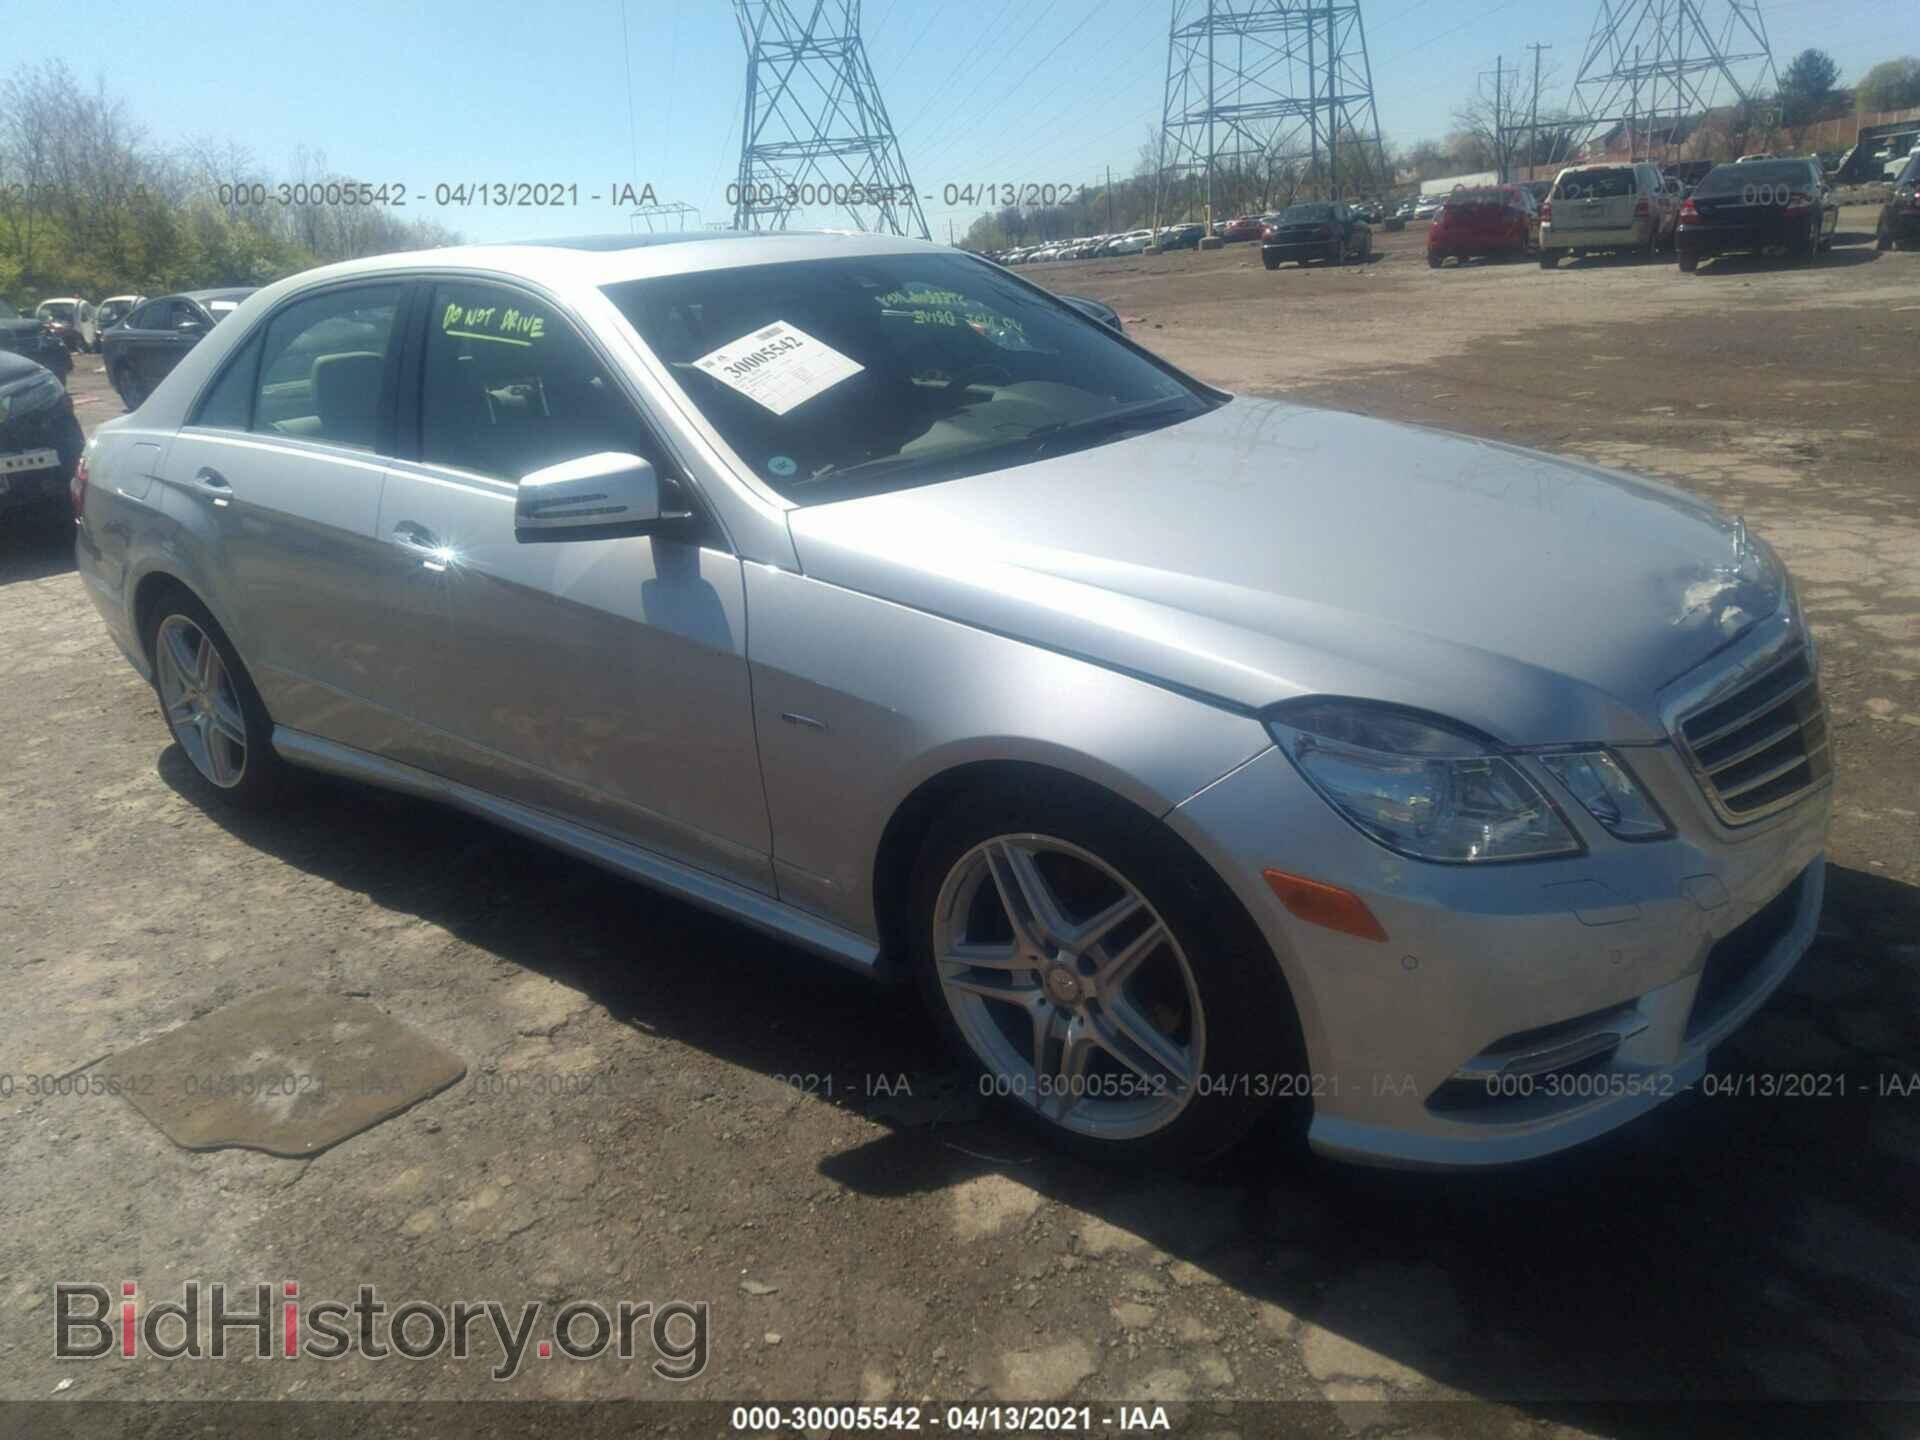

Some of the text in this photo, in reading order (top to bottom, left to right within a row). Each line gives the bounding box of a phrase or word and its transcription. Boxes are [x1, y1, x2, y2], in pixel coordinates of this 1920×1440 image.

[464, 307, 496, 327] NOT
[500, 308, 545, 338] DRIVE
[723, 335, 804, 380] 30005542
